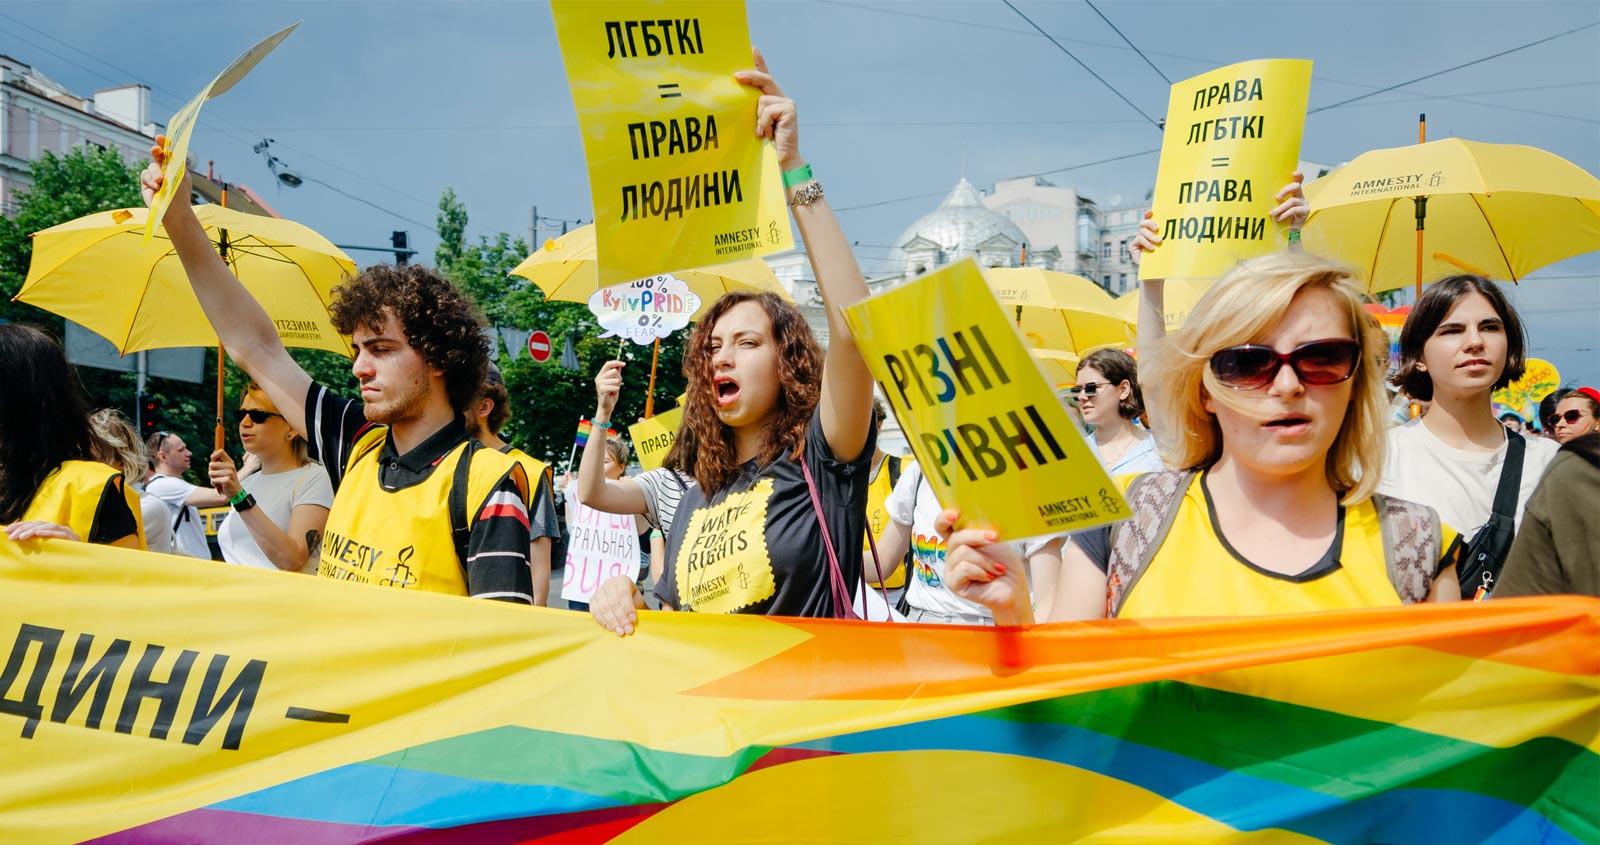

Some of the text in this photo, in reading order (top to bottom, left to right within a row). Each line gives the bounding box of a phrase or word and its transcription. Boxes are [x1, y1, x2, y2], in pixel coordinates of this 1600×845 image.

[605, 18, 704, 59] ЛГБТКІ
[1193, 78, 1263, 111] ПРАВА
[628, 115, 719, 160] ПРАВА
[1186, 115, 1264, 146] ЛГБТКІ
[1178, 179, 1253, 204] ПРАВА
[1350, 183, 1421, 196] INTERNATIONAL
[1352, 173, 1424, 190] AMNESTY
[620, 169, 743, 223] ЛЮДИНИ
[714, 227, 760, 246] AMNESTY
[1162, 216, 1266, 243] ЛЮДИНИ
[715, 241, 763, 255] INTERNATIONAL
[626, 327, 656, 337] FEAR
[883, 324, 1011, 411] РІЗНІ
[641, 430, 675, 455] ПРАВА
[920, 404, 1067, 487] РІВНІ
[1038, 496, 1091, 518] AMNESTY
[572, 526, 633, 559] РАЛЬНАЯ
[688, 530, 748, 573] RIGHTS
[693, 529, 728, 553] FOR
[691, 575, 727, 598] AMNESTY
